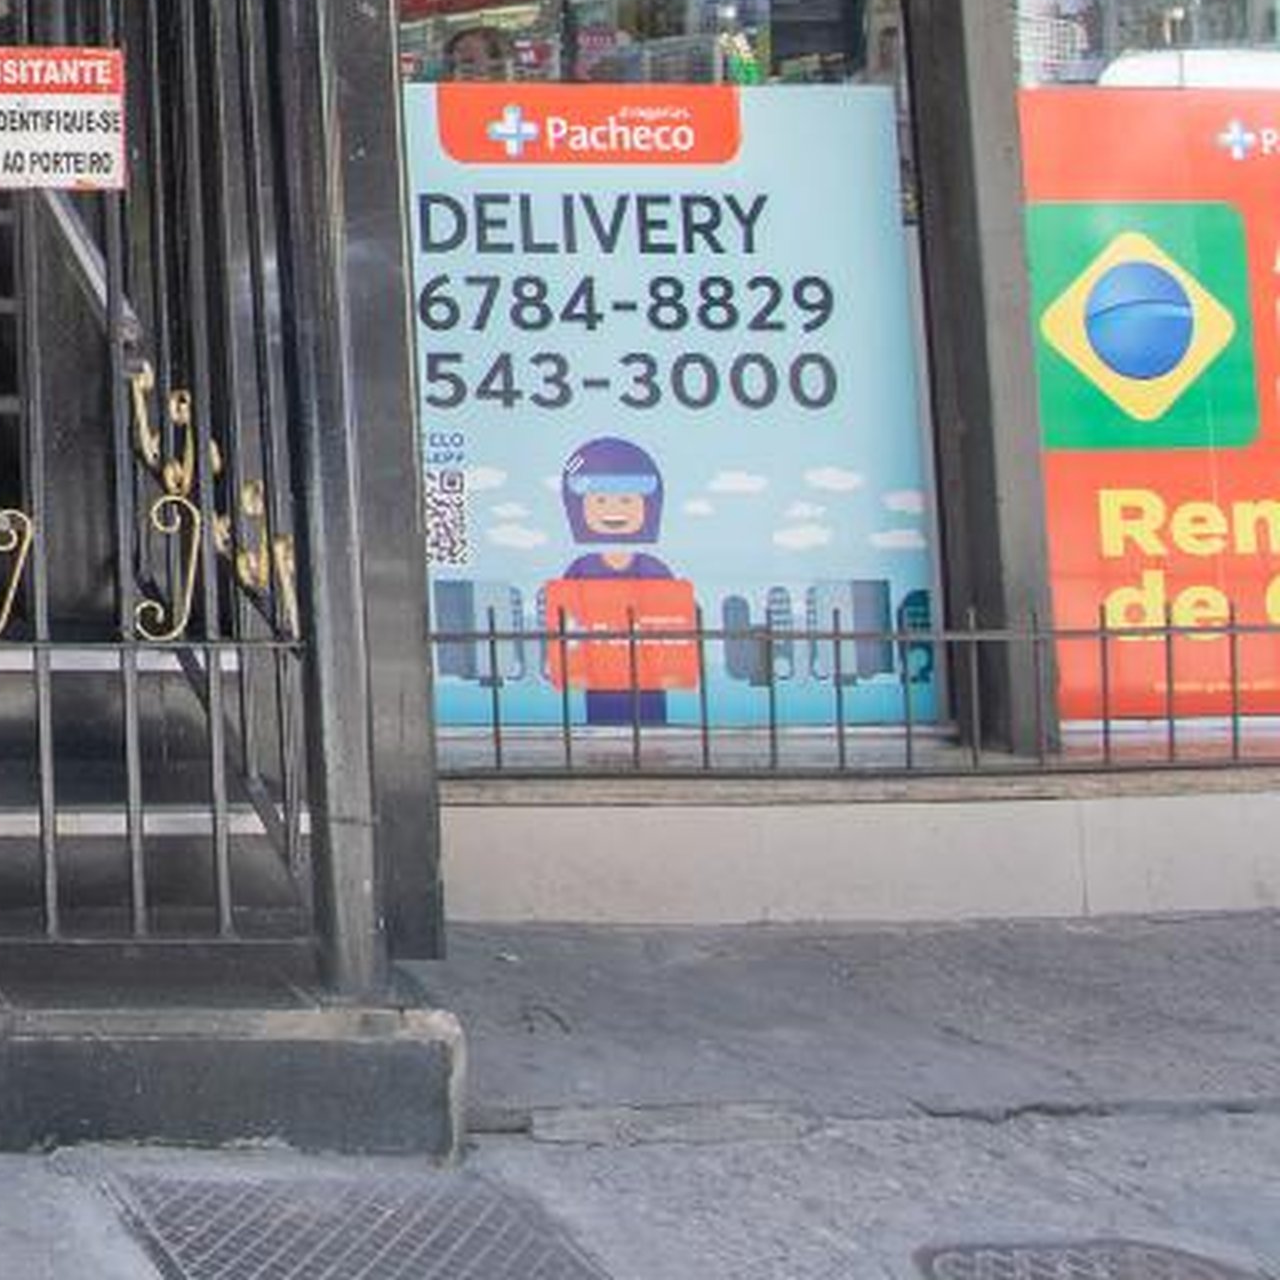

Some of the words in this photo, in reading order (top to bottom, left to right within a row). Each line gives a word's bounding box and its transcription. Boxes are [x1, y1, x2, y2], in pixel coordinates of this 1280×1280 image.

[2, 150, 26, 174] AO
[29, 150, 114, 174] PORTEIRO
[546, 116, 695, 151] Pacheco
[418, 193, 768, 255] DELIVERY
[418, 274, 835, 333] 6784-8829
[425, 351, 838, 409] 543-3000
[1104, 569, 1231, 641] de
